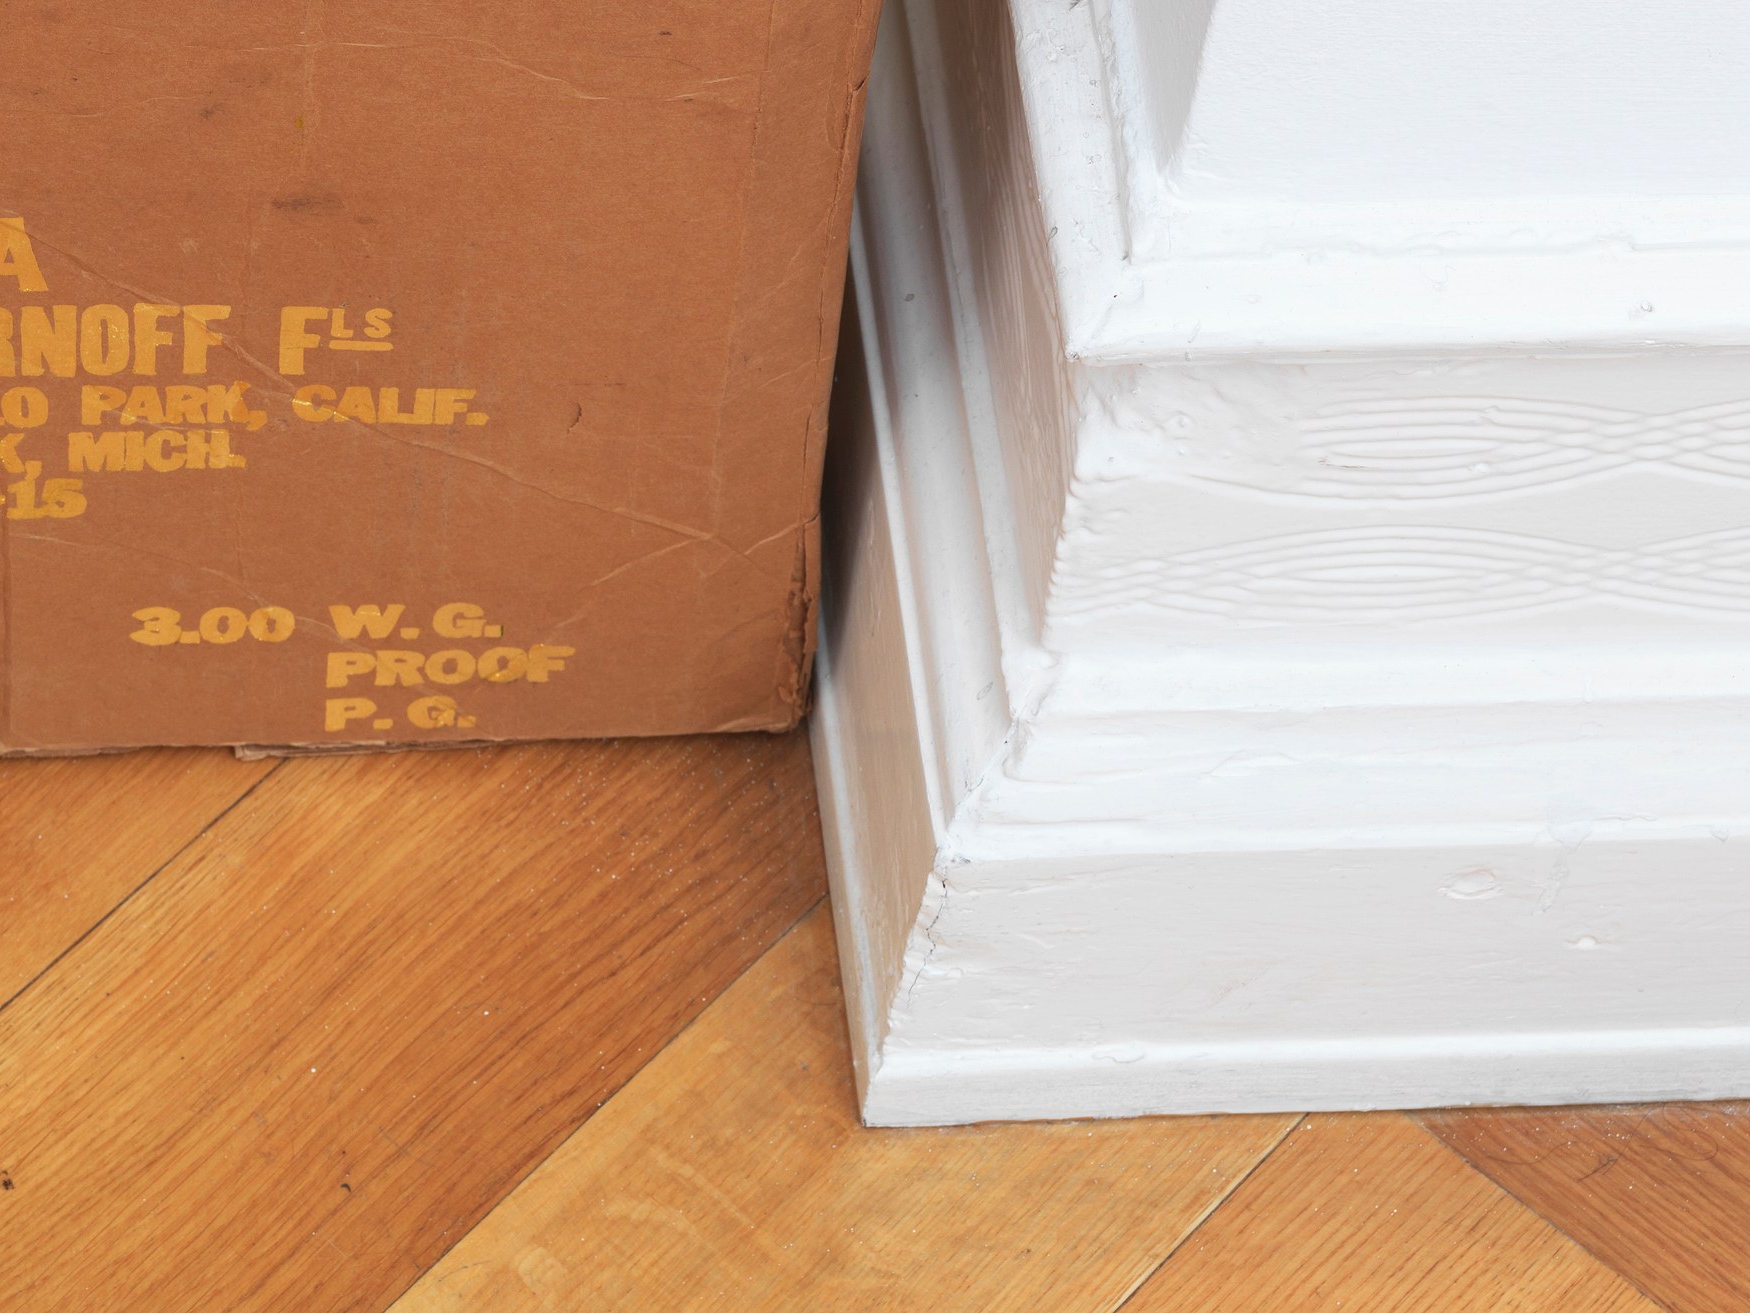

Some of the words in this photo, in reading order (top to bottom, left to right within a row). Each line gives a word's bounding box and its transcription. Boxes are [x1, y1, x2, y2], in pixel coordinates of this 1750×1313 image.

[82, 380, 269, 431] PARK,
[292, 385, 490, 427] CALIF.
[68, 429, 246, 473] MICH.
[129, 606, 296, 647] 3.00
[326, 643, 577, 689] PROOF
